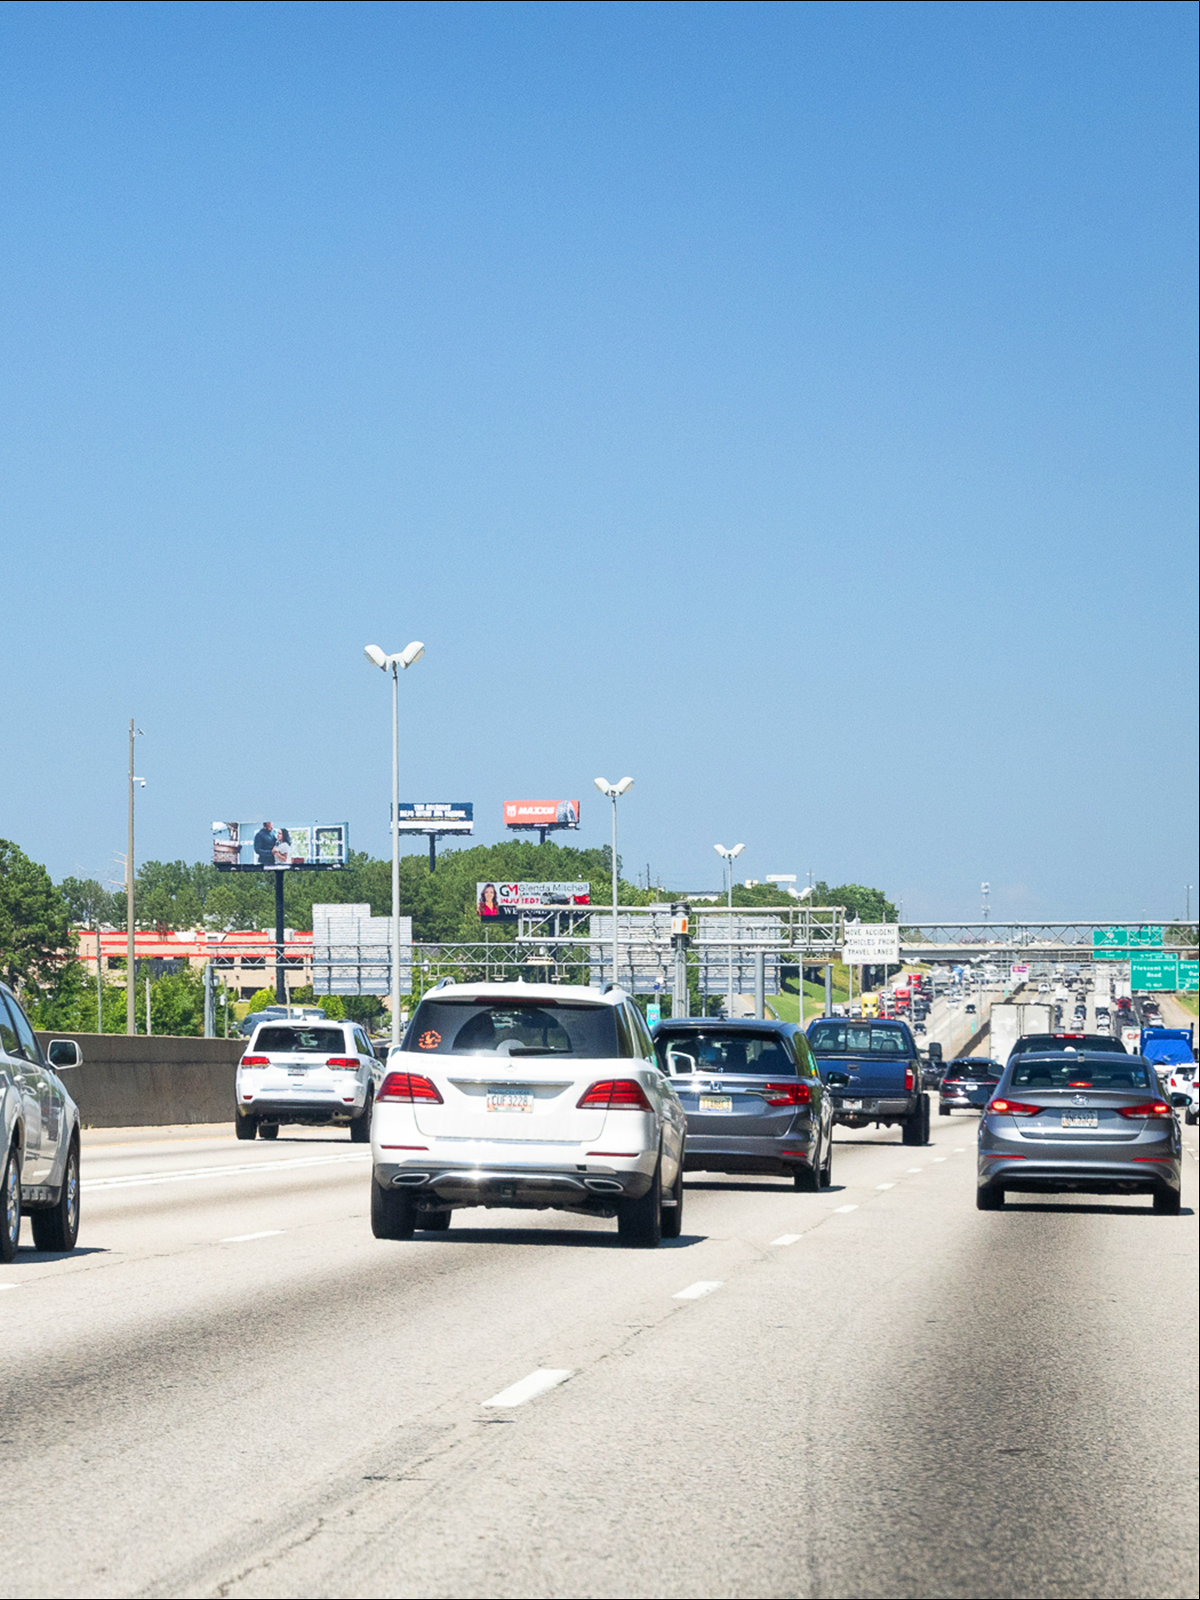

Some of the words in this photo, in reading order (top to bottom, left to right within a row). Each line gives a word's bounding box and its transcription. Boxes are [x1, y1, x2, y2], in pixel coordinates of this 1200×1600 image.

[517, 806, 555, 815] MAXXIS
[499, 884, 518, 897] GM
[518, 884, 551, 892] Glenda
